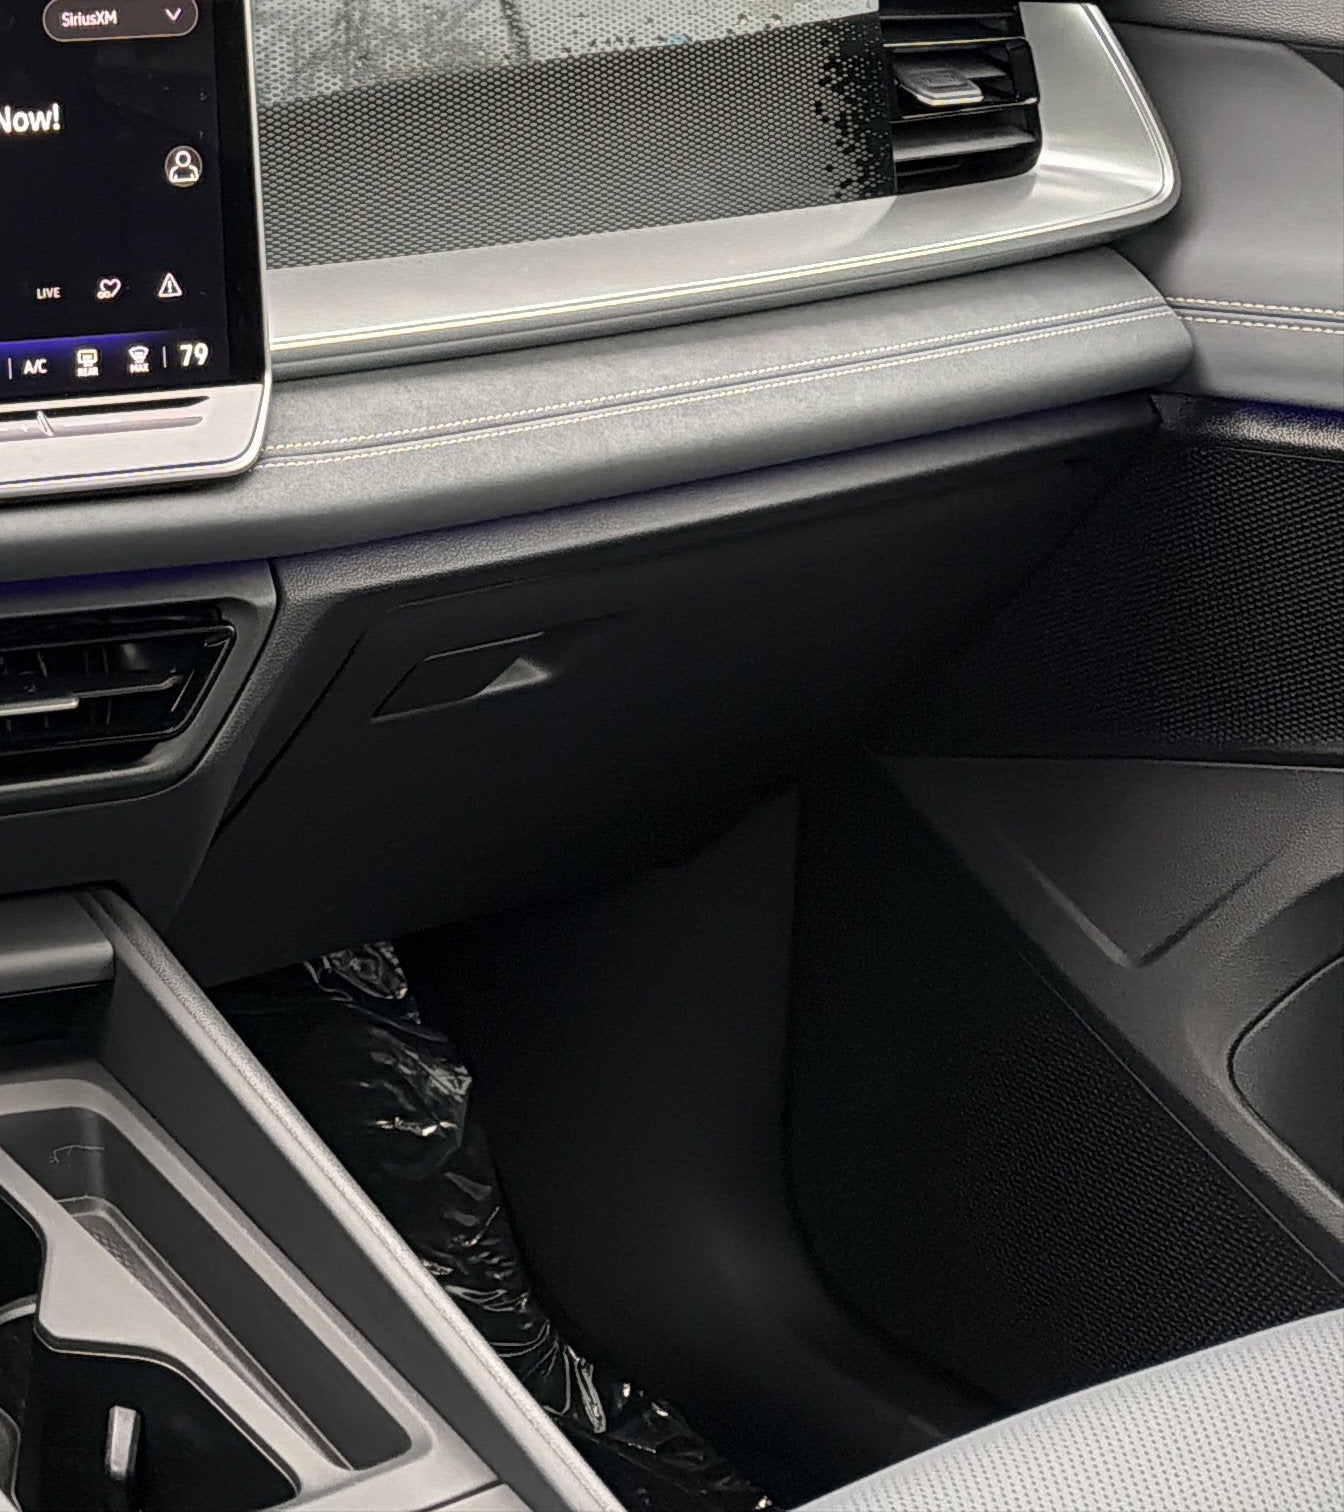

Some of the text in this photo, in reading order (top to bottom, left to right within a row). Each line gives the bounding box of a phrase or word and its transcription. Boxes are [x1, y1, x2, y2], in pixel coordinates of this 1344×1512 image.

[61, 9, 118, 28] SiriusXM
[36, 286, 62, 300] LIVE
[179, 343, 209, 368] 79
[23, 358, 48, 376] A/C
[77, 365, 99, 378] REAR
[128, 362, 150, 374] MAX
